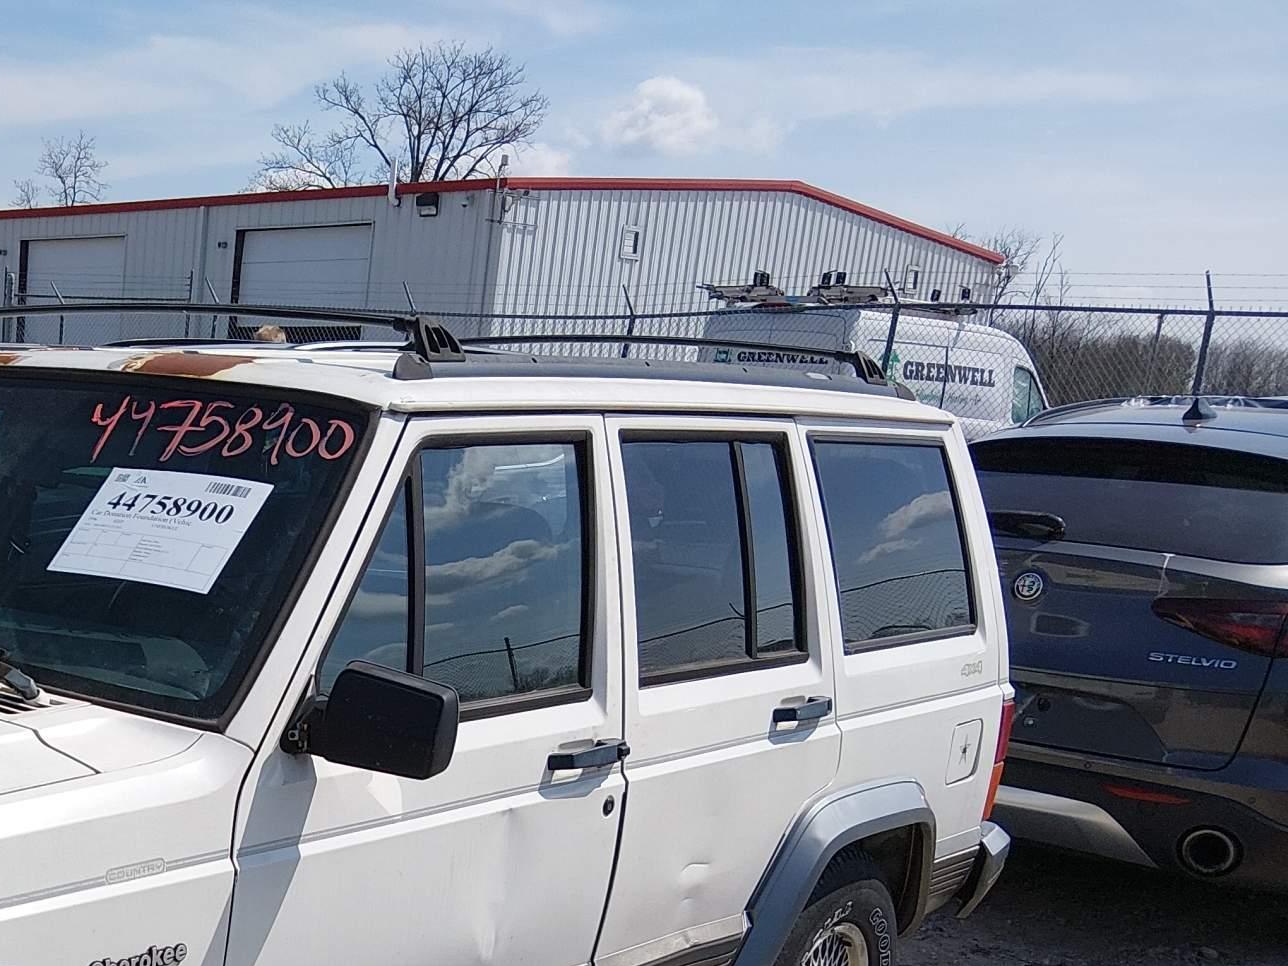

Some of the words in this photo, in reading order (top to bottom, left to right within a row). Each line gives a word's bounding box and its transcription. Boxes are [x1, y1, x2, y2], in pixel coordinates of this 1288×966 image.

[737, 351, 828, 365] GREENWELL
[903, 359, 996, 388] GREENWELL
[90, 395, 355, 465] 44758900
[107, 490, 235, 525] 44758900
[1147, 651, 1238, 669] STELVIO
[107, 862, 164, 882] COUNTRY
